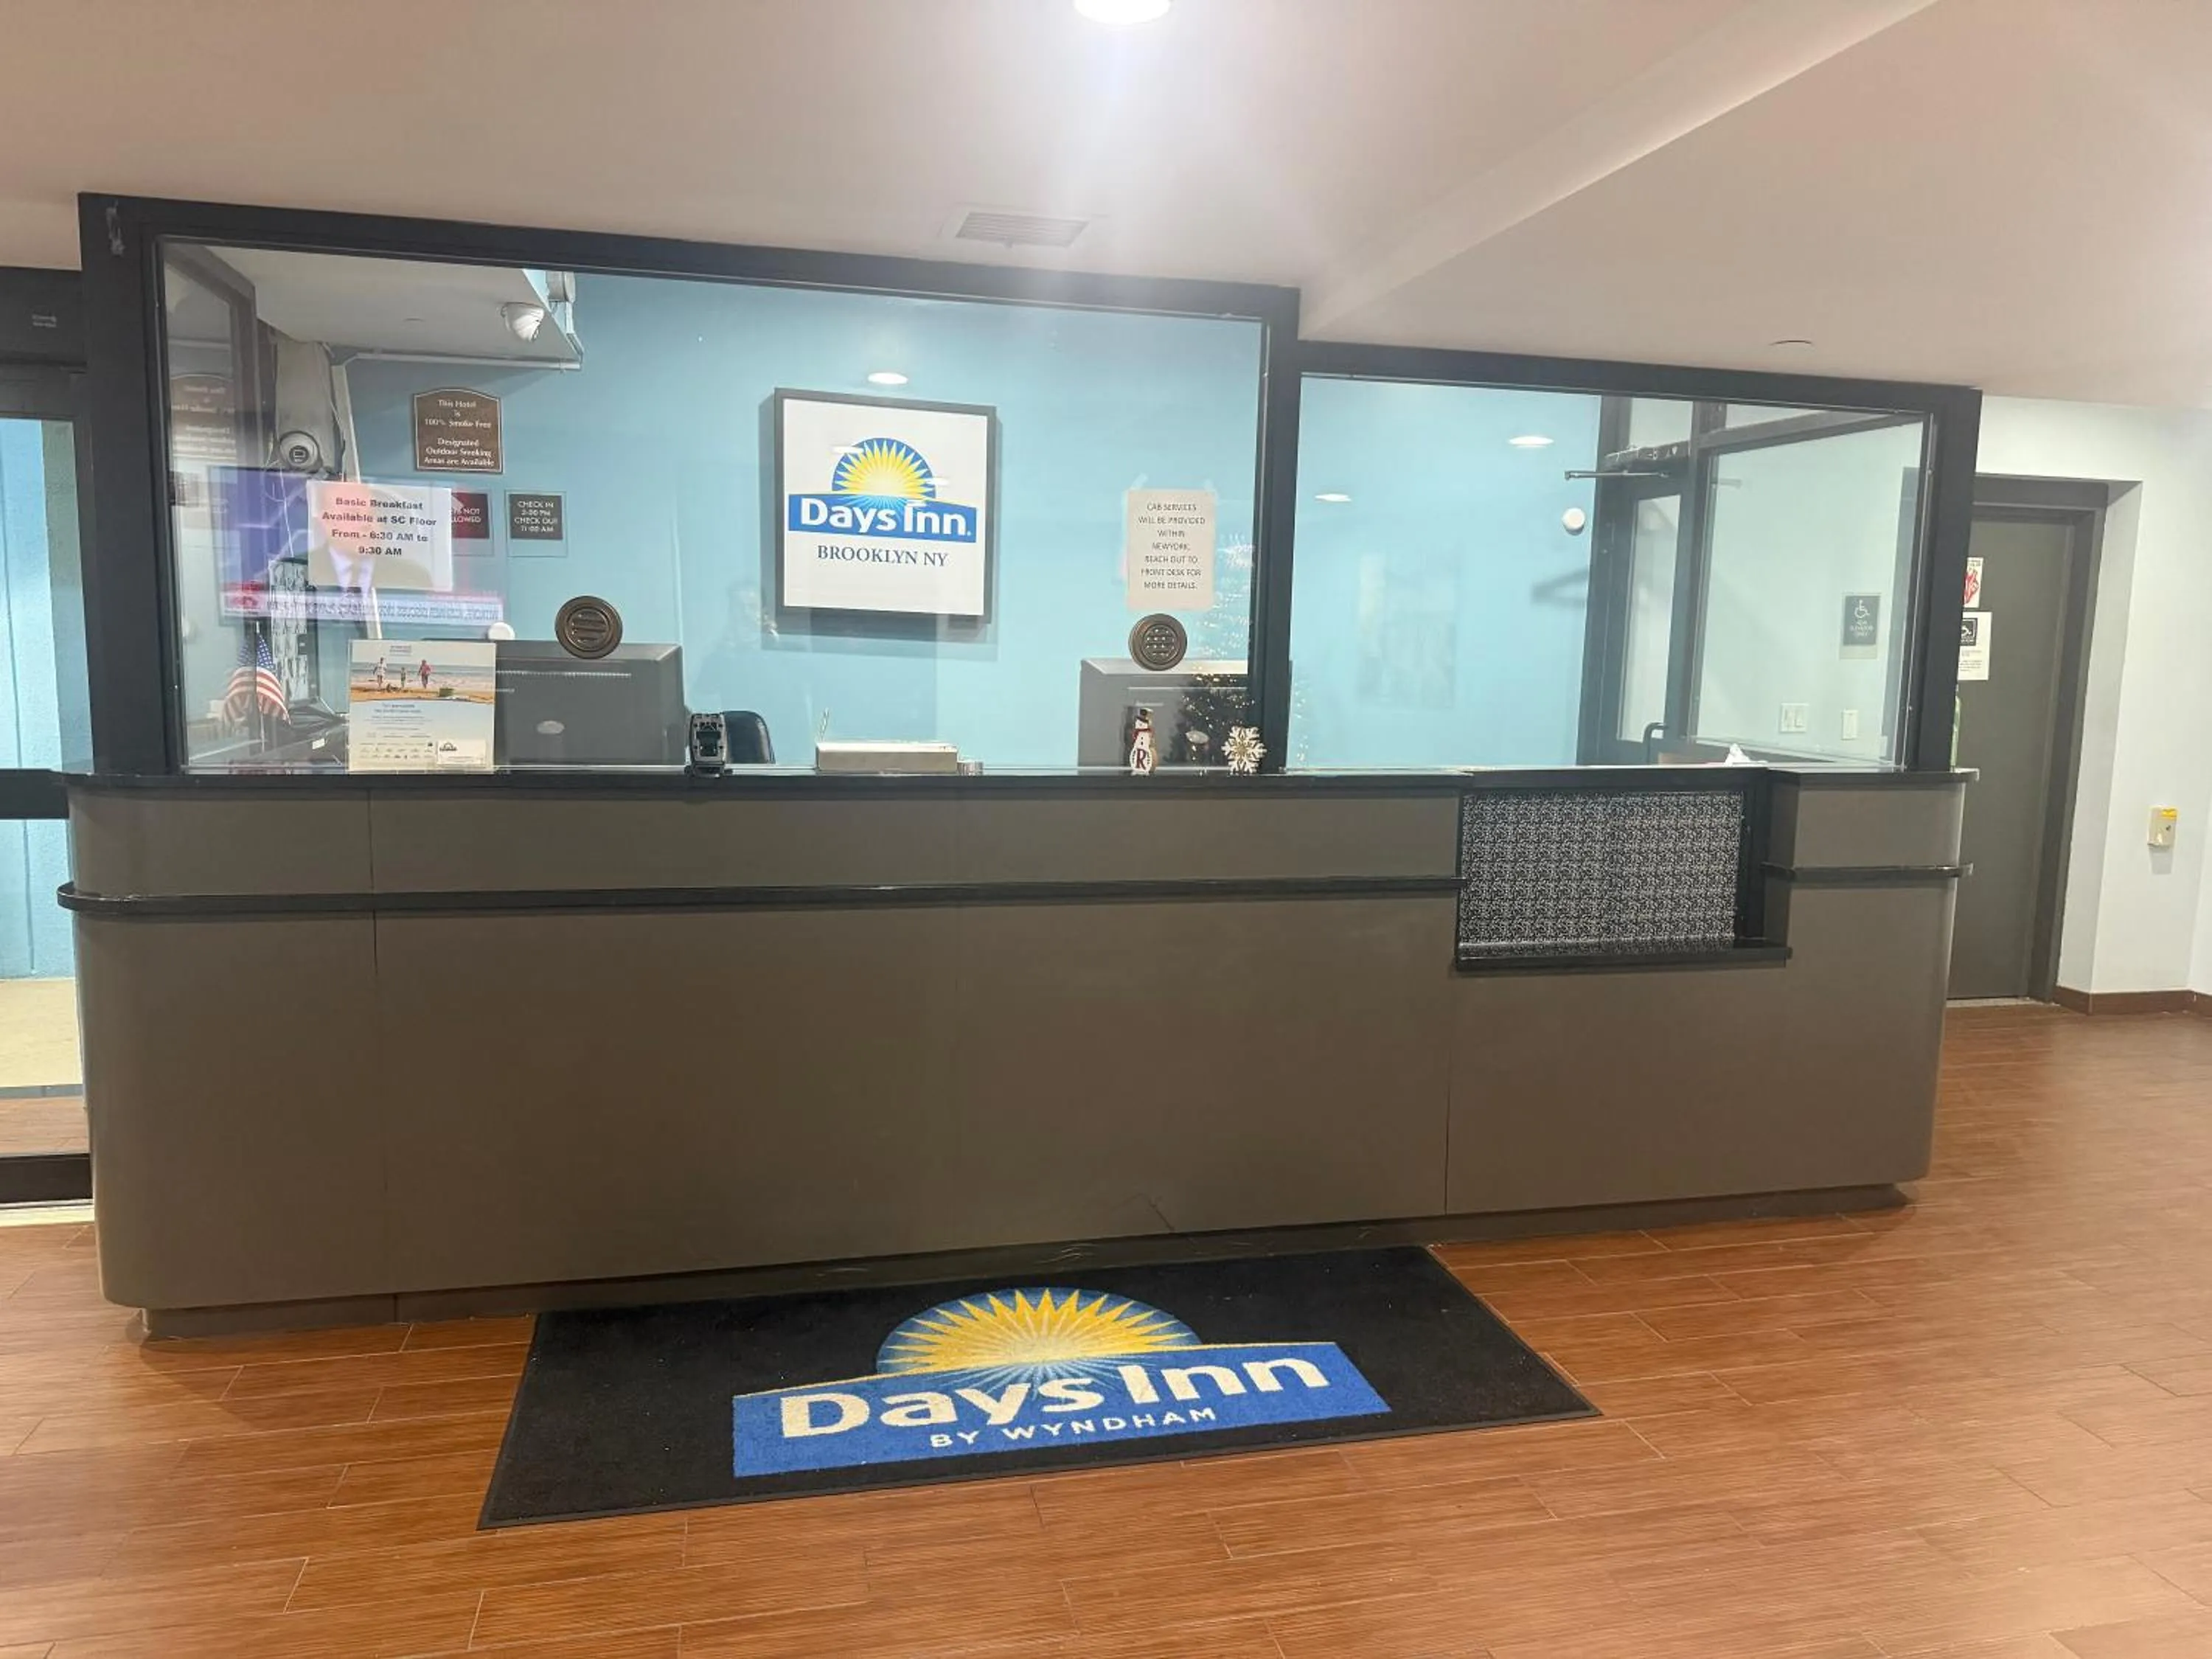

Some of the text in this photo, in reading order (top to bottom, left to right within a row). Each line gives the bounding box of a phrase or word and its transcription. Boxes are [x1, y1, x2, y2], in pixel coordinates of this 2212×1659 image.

[437, 437, 480, 447] Designated
[425, 447, 492, 457] Outdoor Smoking
[461, 458, 495, 466] Available
[335, 497, 423, 509] Basic Breakfast
[1147, 503, 1162, 511] CAB
[321, 512, 437, 526] Available at SC Floor
[801, 498, 968, 536] Days Inn
[332, 529, 360, 538] From
[369, 532, 394, 540] 6:30
[396, 532, 414, 541] AM
[417, 533, 428, 542] to
[358, 546, 382, 554] 9:30
[818, 545, 949, 567] BROOKLYN NY
[1135, 748, 1147, 770] R
[780, 1357, 1329, 1438] Days Inn
[930, 1408, 1216, 1448] BY WYNDHAM
